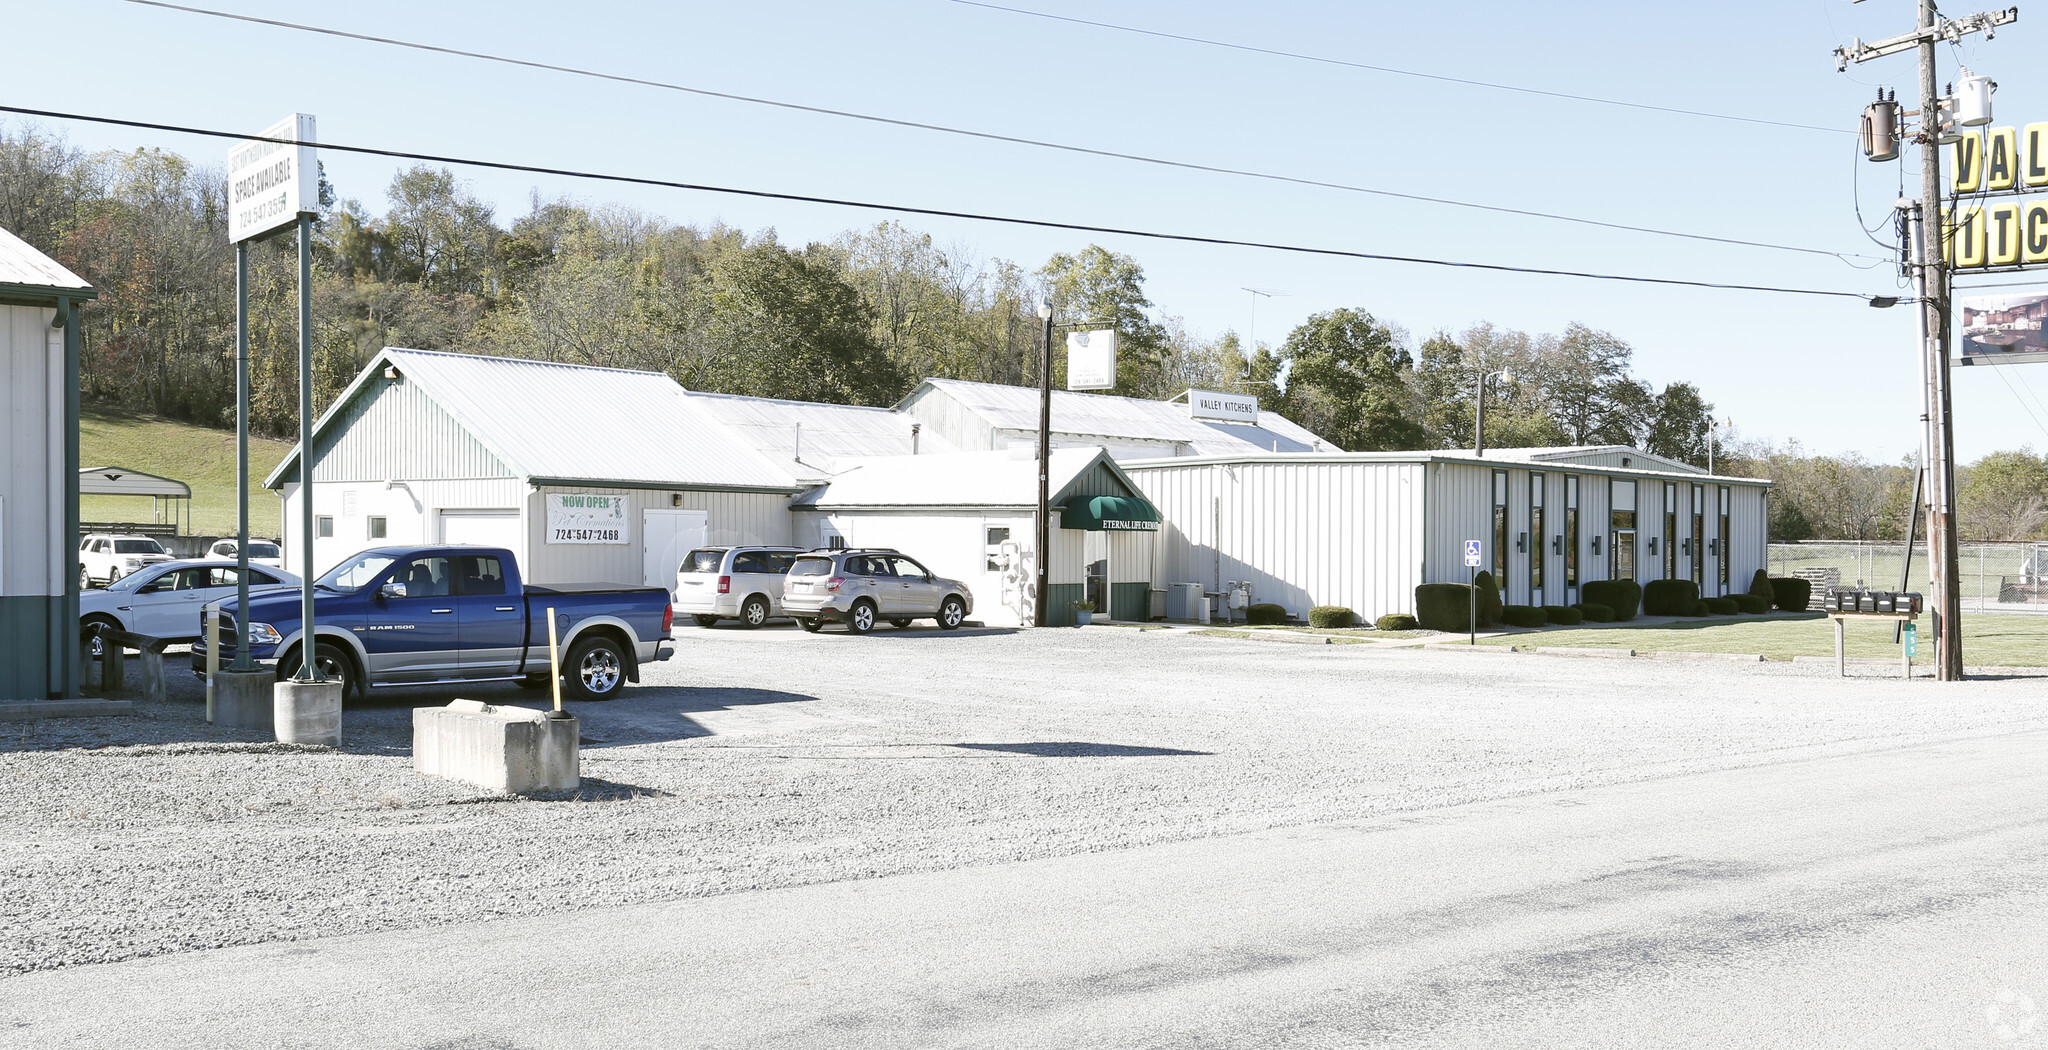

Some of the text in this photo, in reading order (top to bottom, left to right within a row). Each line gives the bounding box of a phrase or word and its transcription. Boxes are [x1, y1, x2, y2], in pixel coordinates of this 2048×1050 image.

[1956, 131, 2046, 184] VAL
[235, 157, 291, 204] SPACE AVAILABLE
[240, 209, 252, 230] 724
[253, 202, 267, 224] 547
[1941, 206, 2048, 260] ITC
[1199, 398, 1253, 414] VALLEY KITCHENS
[562, 495, 610, 509] NOW OPEN
[555, 529, 619, 541] 724-547-2468
[1102, 519, 1131, 529] ETERNAL
[1131, 520, 1142, 530] LIFE
